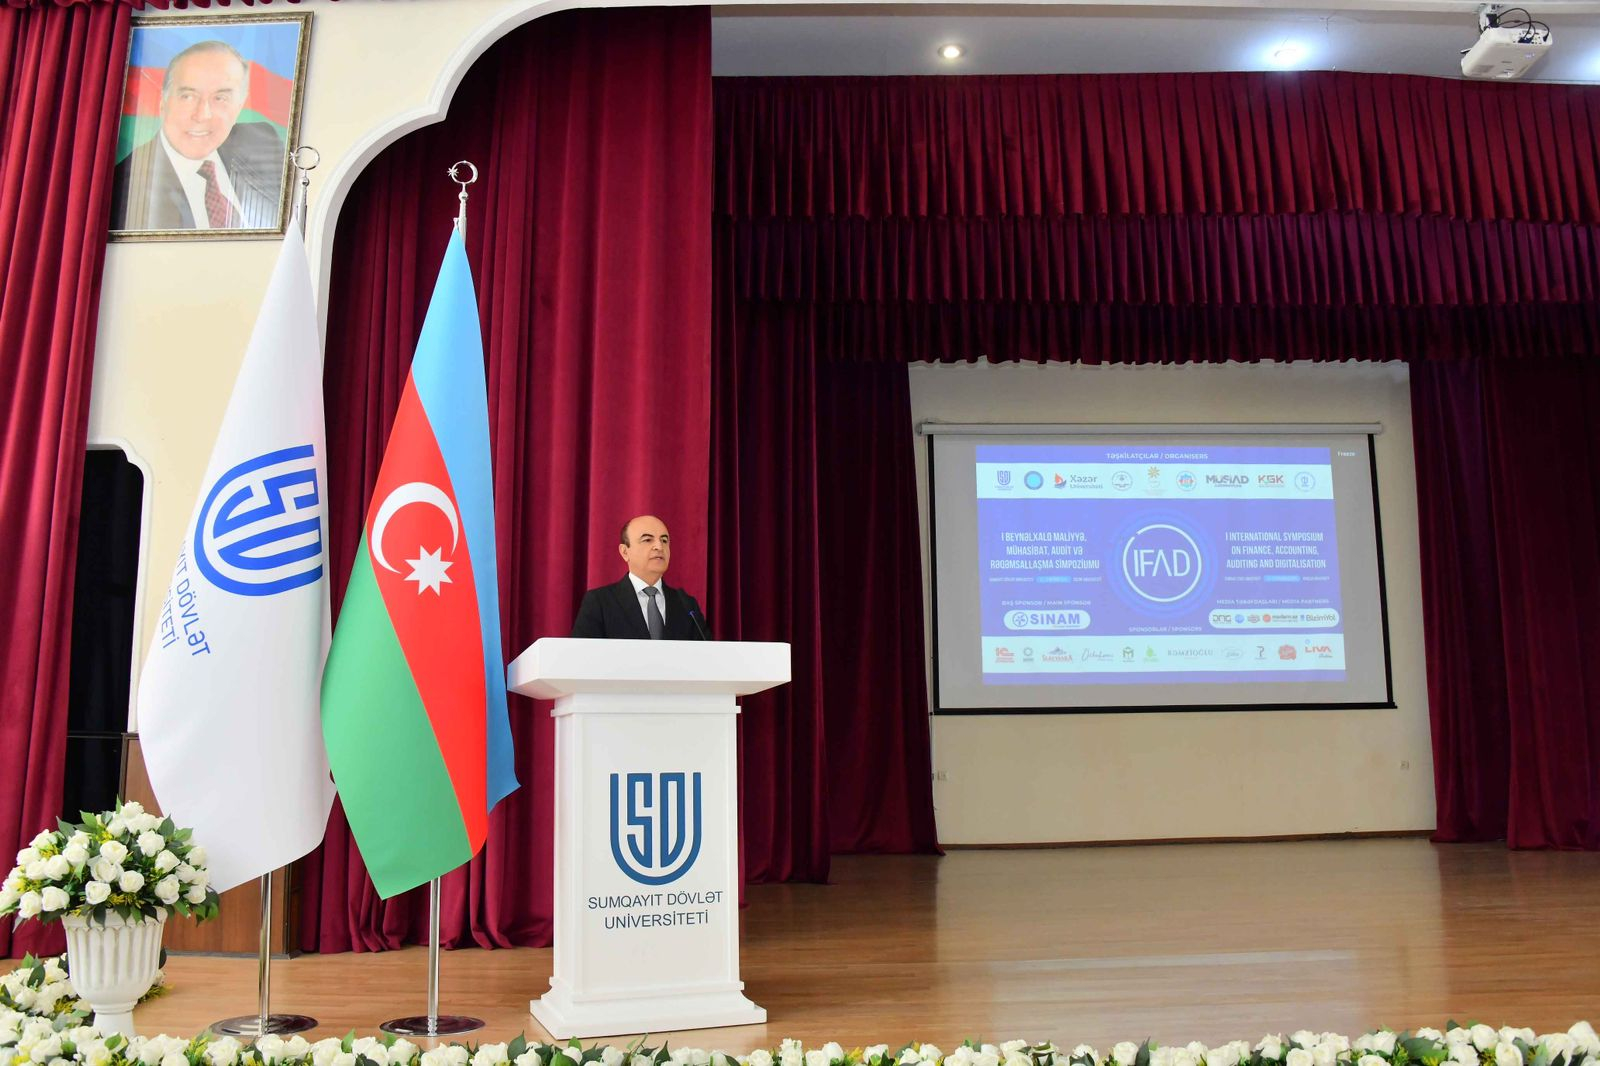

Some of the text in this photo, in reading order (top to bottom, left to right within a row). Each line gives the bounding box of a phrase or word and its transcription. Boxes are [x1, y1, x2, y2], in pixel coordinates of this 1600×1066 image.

[1229, 532, 1282, 541] INTERNATIONAL
[1283, 532, 1324, 541] SYMPOSIUM
[1231, 545, 1320, 556] ON FINANCE, ACCOUNTING,
[1133, 549, 1191, 577] IFAD
[1226, 559, 1326, 569] AUDITING AND DIGITALISATION
[176, 578, 211, 656] DÖVLƏT
[1030, 613, 1081, 625] SINAM
[588, 890, 723, 909] SUMQAYIT DÖVLƏT
[604, 909, 709, 929] UNİVERSİTETİ
